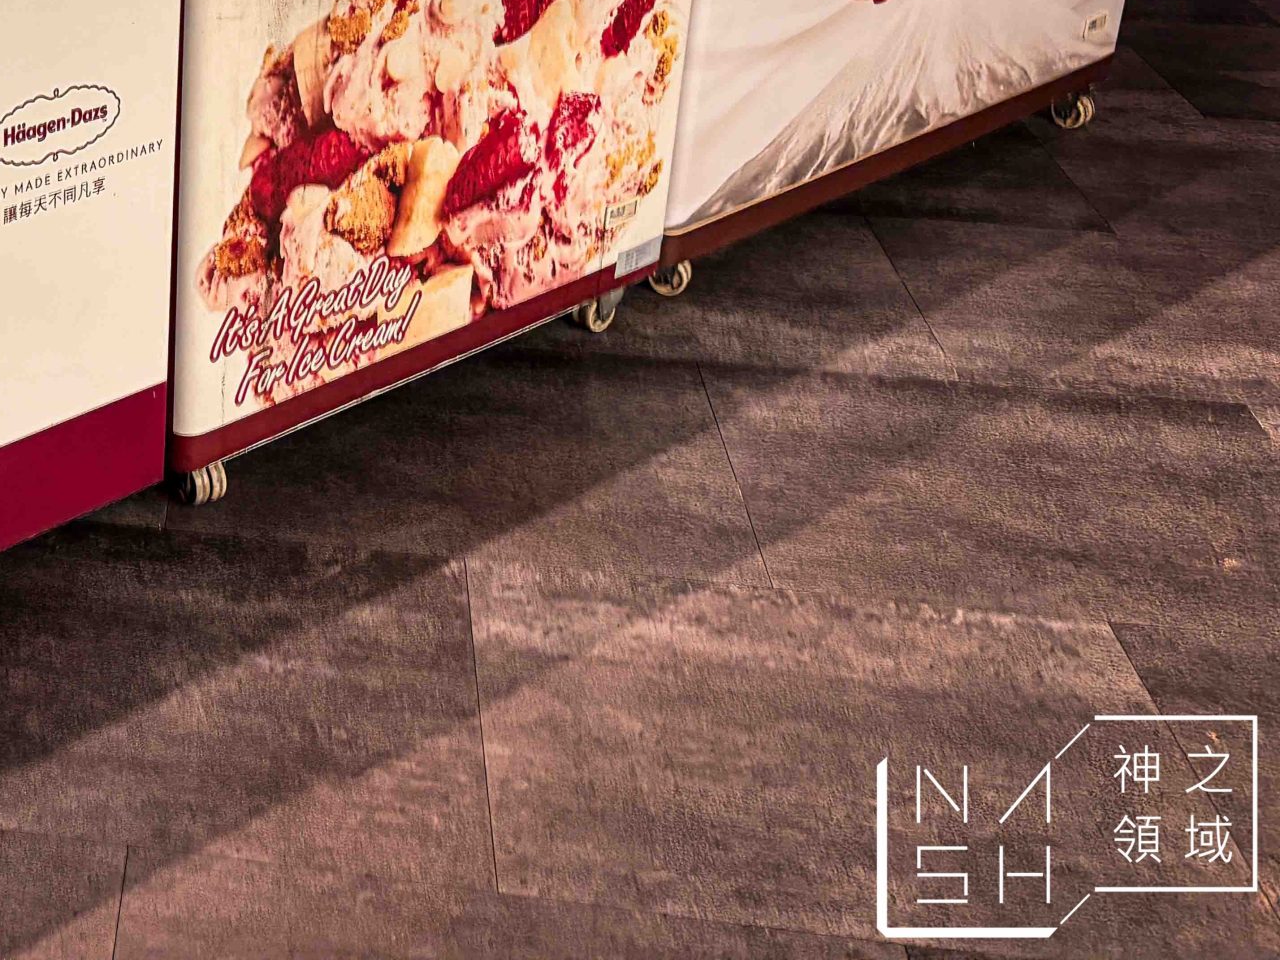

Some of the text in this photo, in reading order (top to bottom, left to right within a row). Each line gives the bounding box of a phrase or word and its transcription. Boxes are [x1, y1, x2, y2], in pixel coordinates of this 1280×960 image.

[3, 104, 108, 148] Häagen-Dazs
[14, 173, 52, 196] MADE
[57, 138, 164, 182] EXTRAORDINARY
[3, 175, 106, 225] 讓每天不同凡享
[210, 255, 412, 363] It's A Great Day
[234, 290, 422, 406] For Ice Cream!
